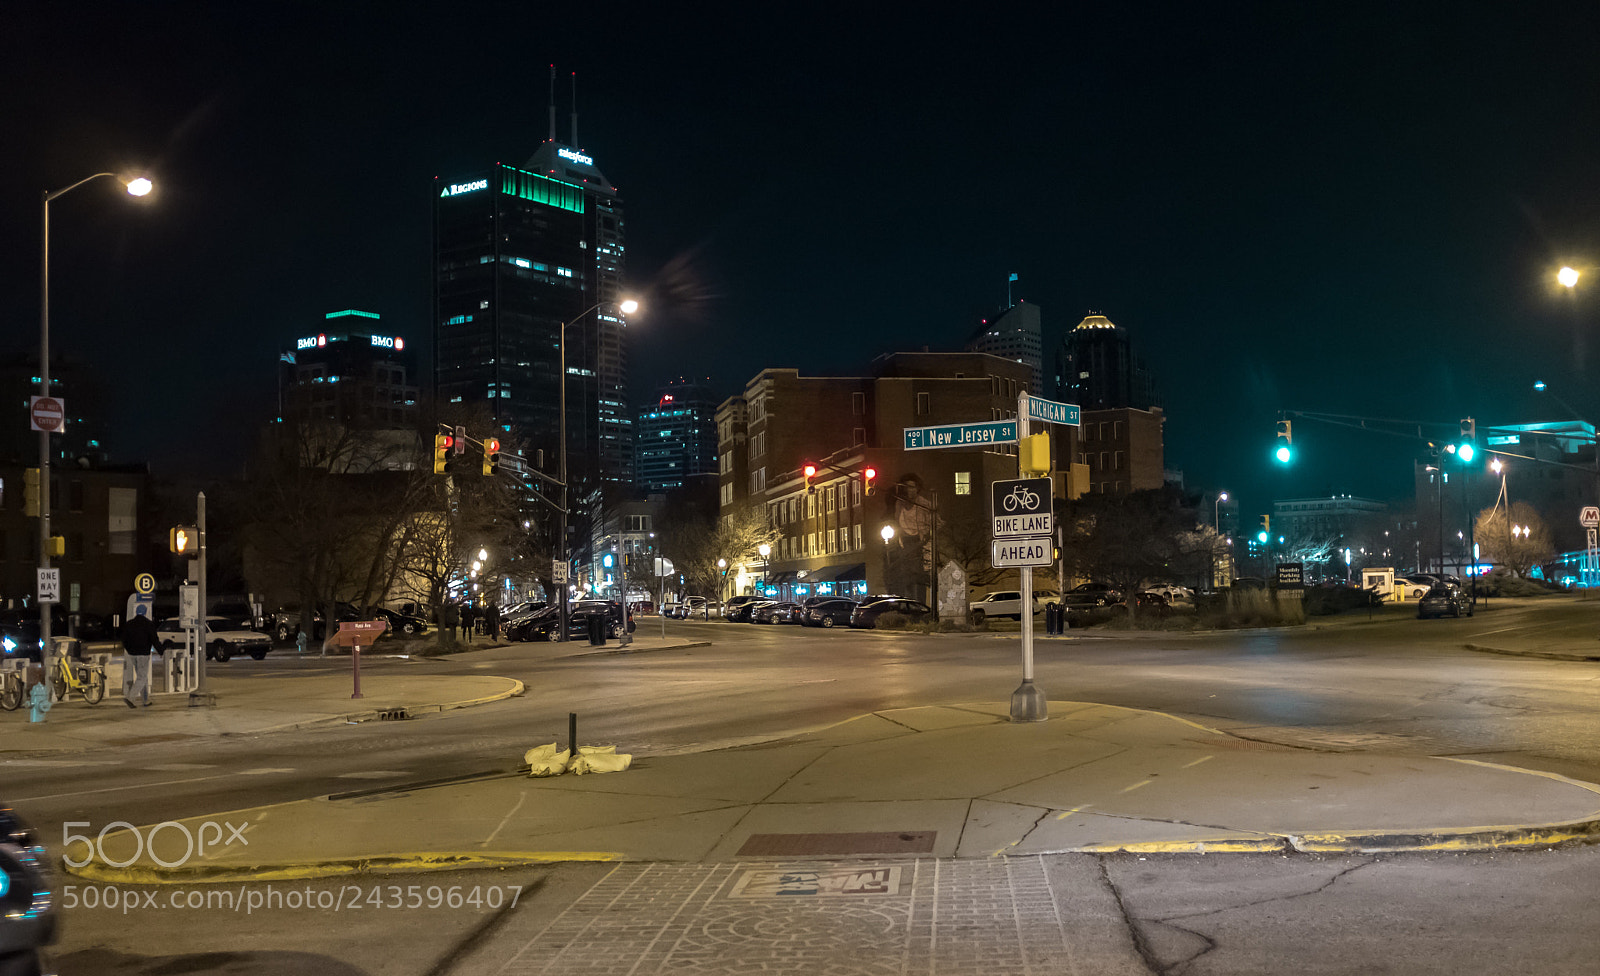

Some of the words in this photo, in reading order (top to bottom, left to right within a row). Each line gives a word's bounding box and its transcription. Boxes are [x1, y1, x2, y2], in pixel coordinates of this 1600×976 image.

[557, 148, 594, 166] salesforce
[450, 179, 488, 196] REGIONS
[297, 337, 318, 350] BMO
[371, 335, 393, 348] BMO
[1031, 399, 1066, 421] MICHIGAN
[1069, 411, 1078, 419] ST
[911, 439, 917, 447] E
[929, 430, 952, 446] New
[957, 427, 996, 444] Jersey
[1002, 427, 1011, 436] St
[1585, 510, 1598, 520] M
[995, 518, 1018, 533] BIKE
[1022, 516, 1050, 531] LANE
[1000, 545, 1044, 560] AHEAD
[40, 572, 57, 580] ONE
[40, 583, 57, 591] WAY
[142, 578, 151, 589] B
